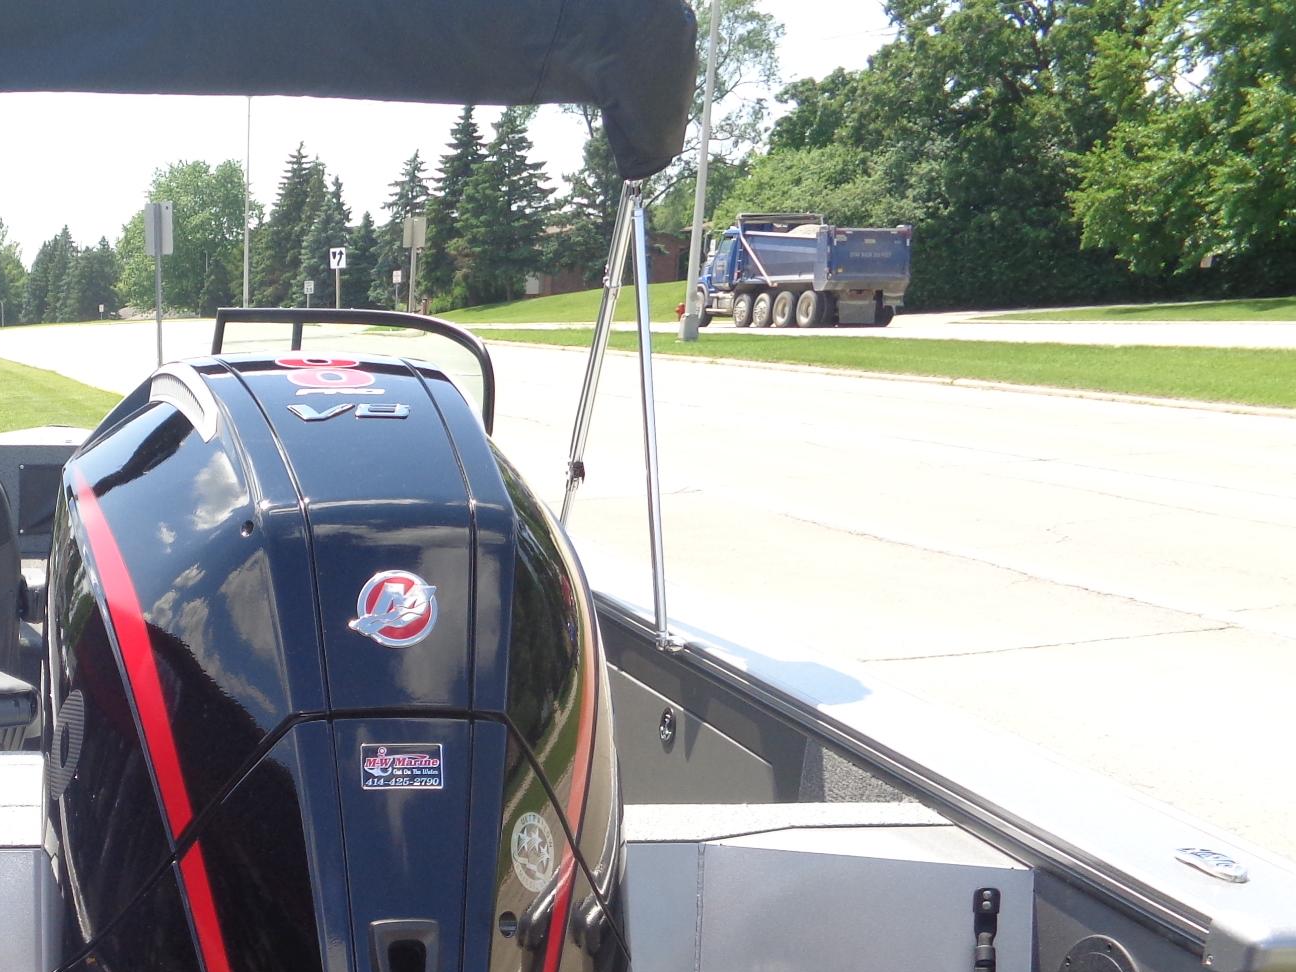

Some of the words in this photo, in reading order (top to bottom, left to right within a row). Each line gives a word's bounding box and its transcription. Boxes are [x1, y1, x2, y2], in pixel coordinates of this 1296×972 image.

[364, 757, 393, 769] M-W
[394, 756, 439, 768] Marine
[365, 777, 440, 786] 414-425-2790
